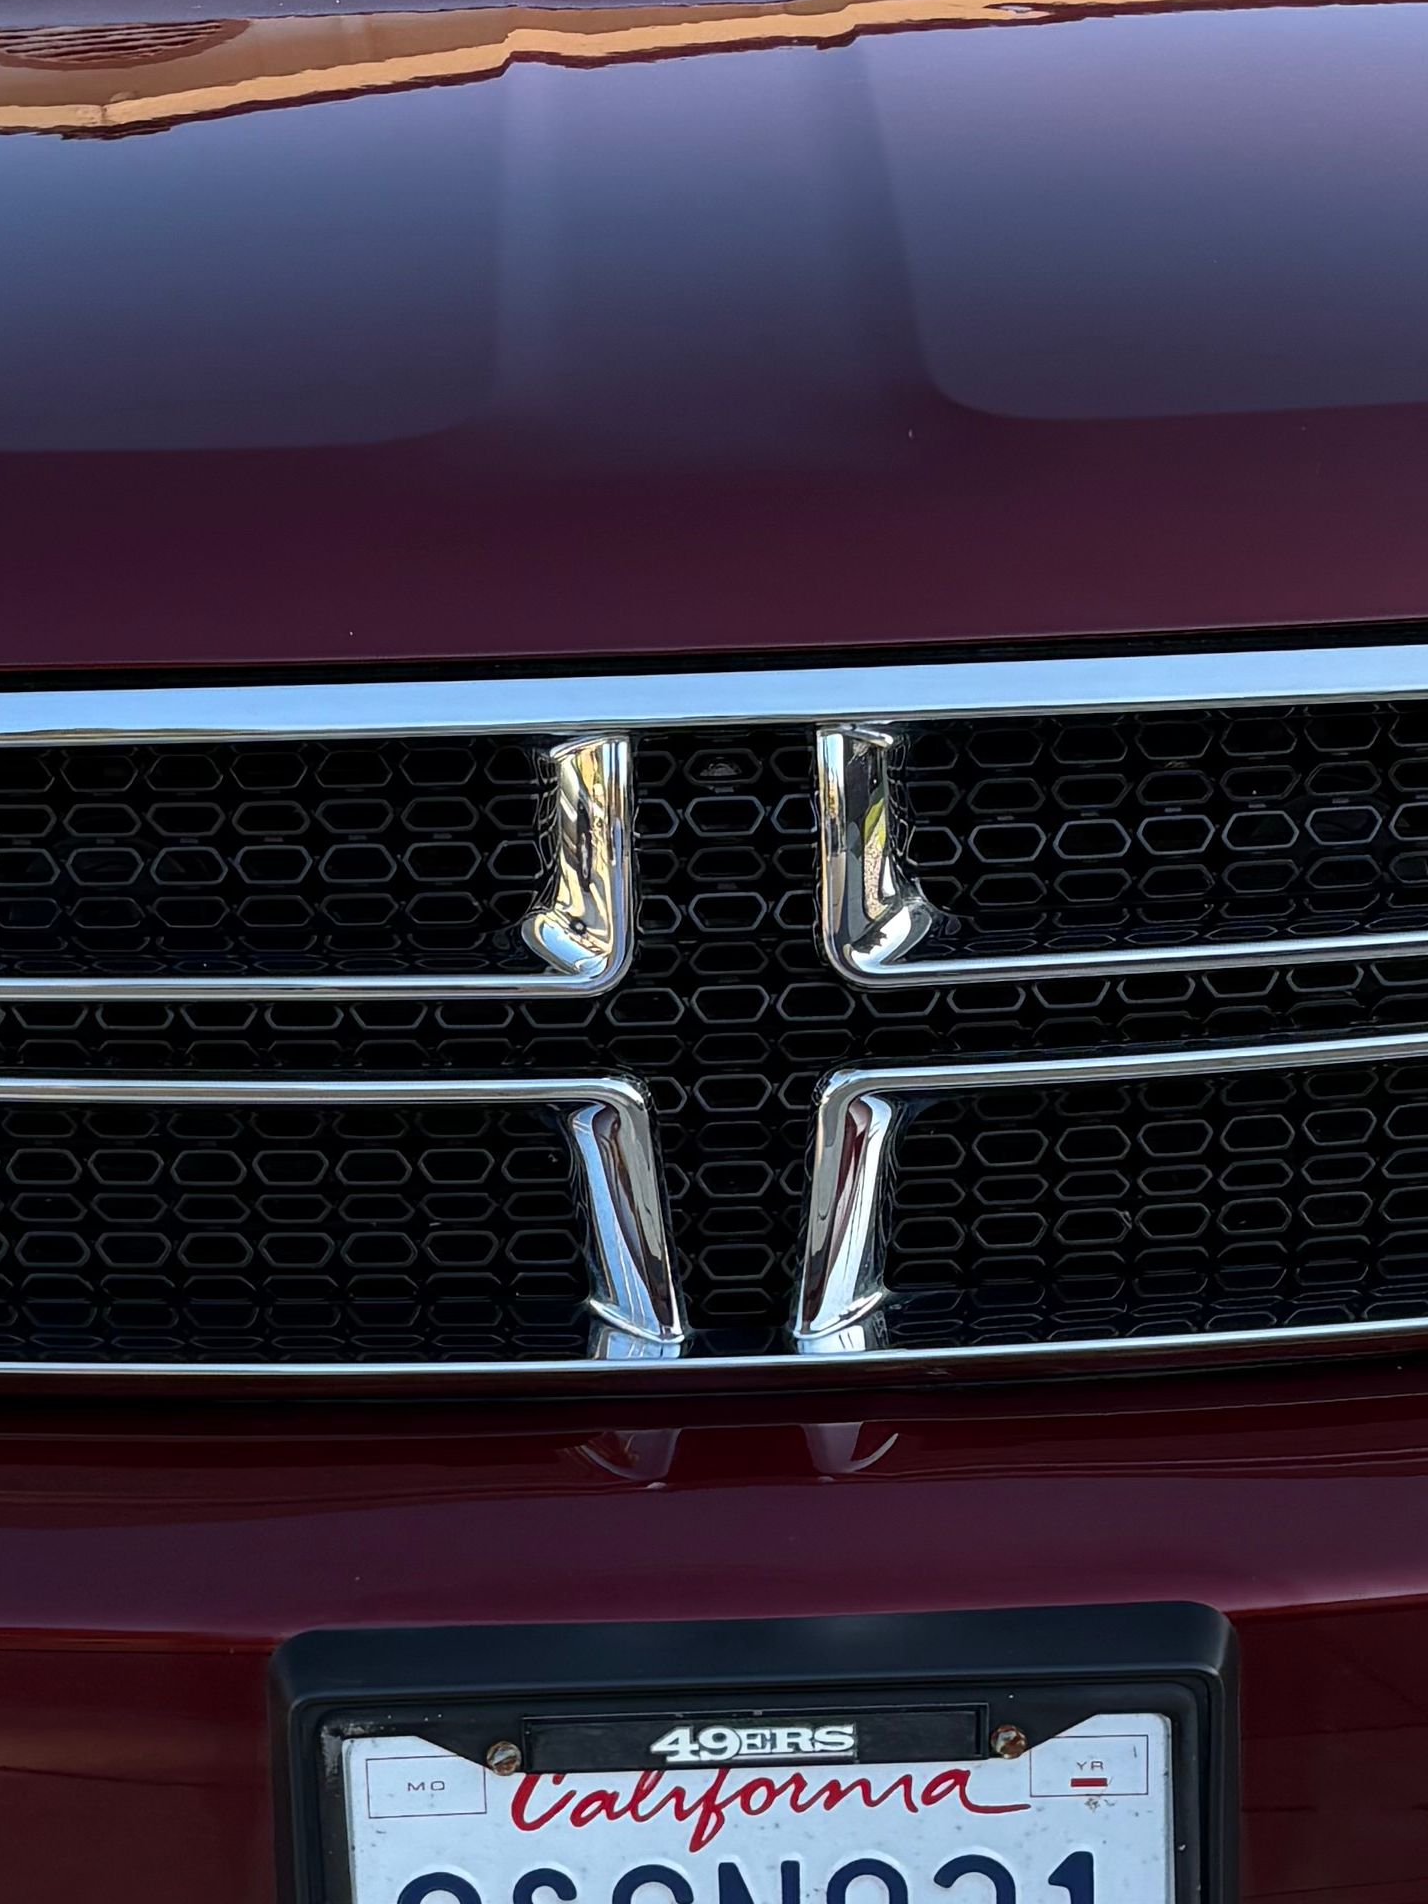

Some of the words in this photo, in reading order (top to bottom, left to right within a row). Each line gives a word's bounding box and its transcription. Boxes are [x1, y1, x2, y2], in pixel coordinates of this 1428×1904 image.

[649, 1723, 856, 1763] 49ERS
[1076, 1760, 1104, 1771] YR
[406, 1780, 445, 1792] MO
[509, 1767, 1031, 1853] California
